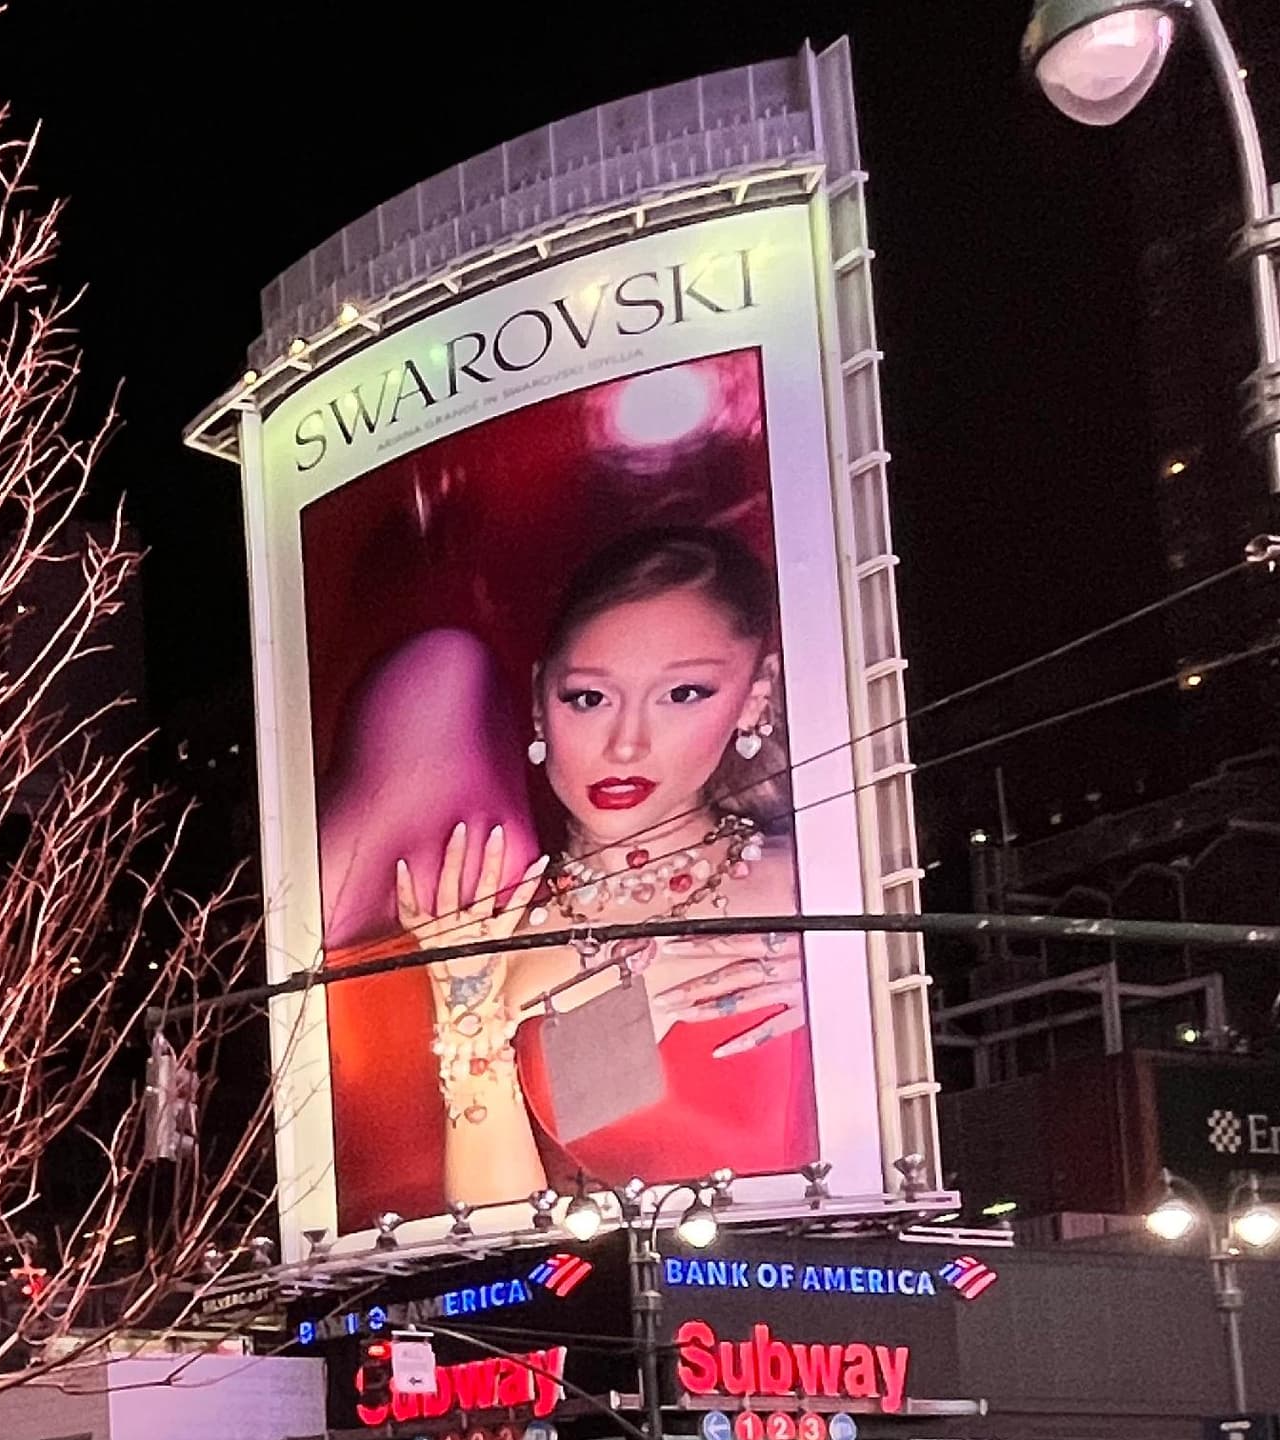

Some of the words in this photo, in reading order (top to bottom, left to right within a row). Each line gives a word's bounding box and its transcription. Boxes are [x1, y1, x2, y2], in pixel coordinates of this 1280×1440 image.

[294, 249, 761, 471] SWAROVSKI
[502, 365, 585, 401] SWAROVSKI
[665, 1257, 749, 1289] BANK
[757, 1262, 795, 1289] OF
[802, 1266, 937, 1296] AMERICA
[677, 1320, 909, 1413] Subway
